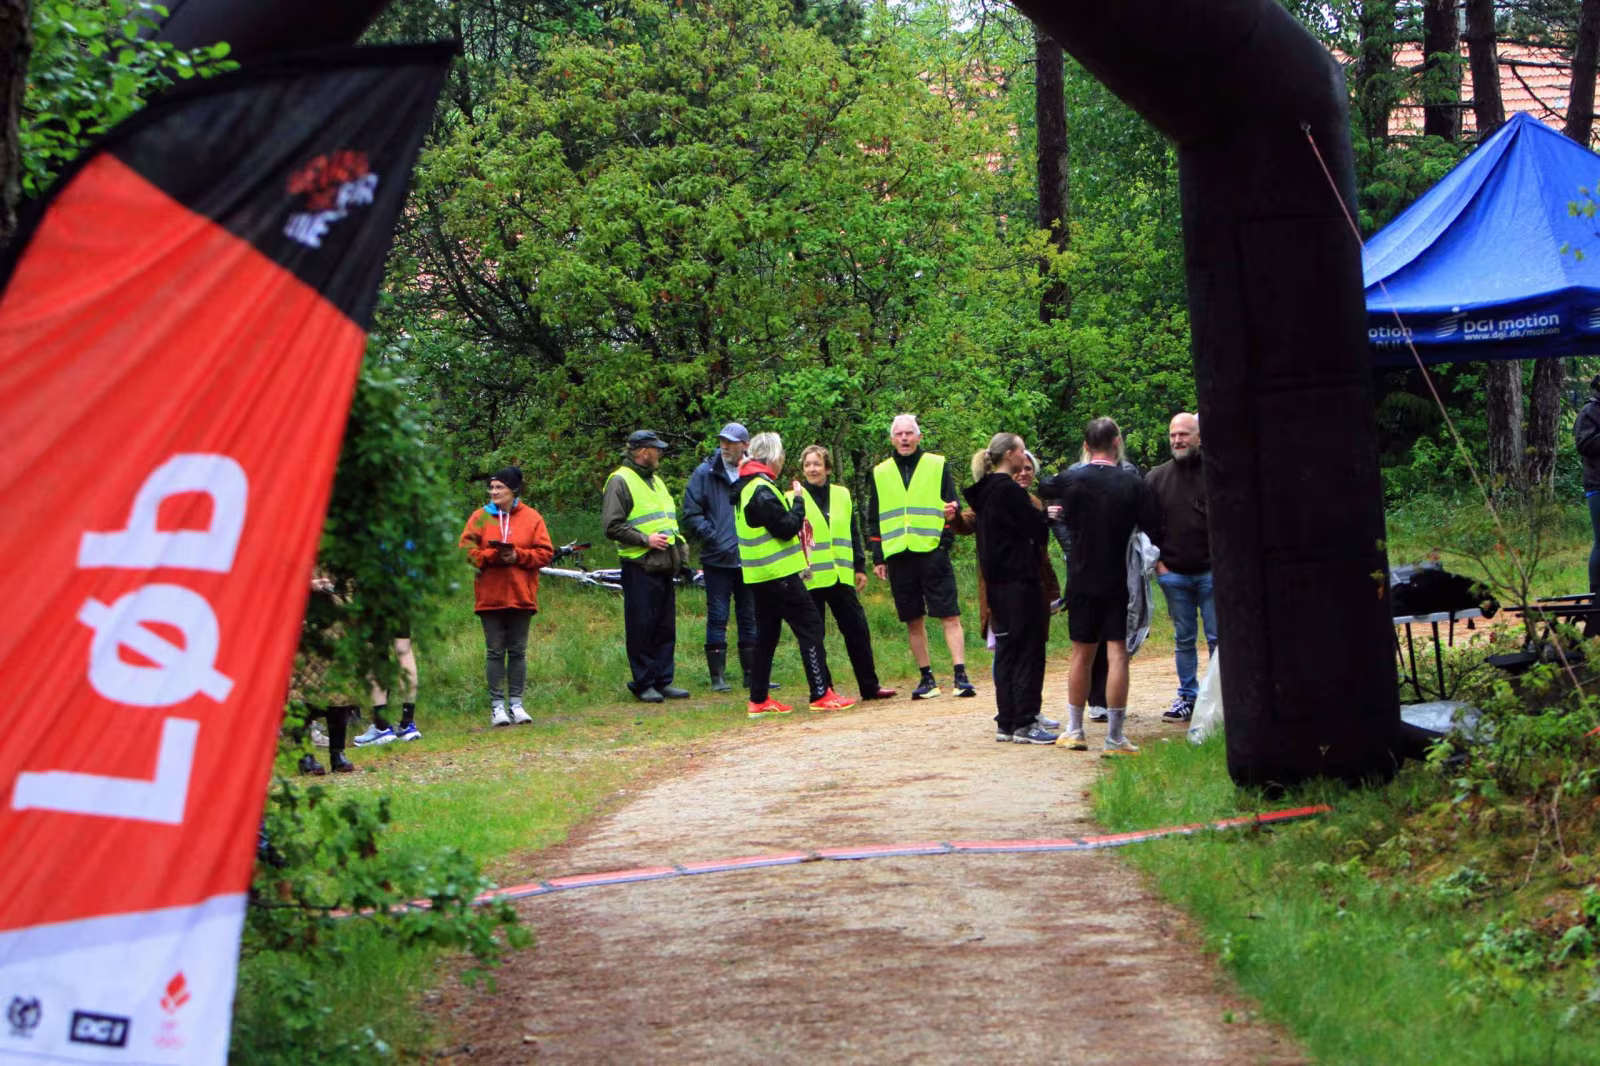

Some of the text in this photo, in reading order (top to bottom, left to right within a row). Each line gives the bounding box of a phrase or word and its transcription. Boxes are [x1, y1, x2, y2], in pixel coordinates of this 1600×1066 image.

[1368, 325, 1412, 338] otion
[1464, 313, 1560, 333] DGI motion
[1464, 326, 1560, 340] www.dgi.dk/motion
[11, 453, 249, 824] Løb
